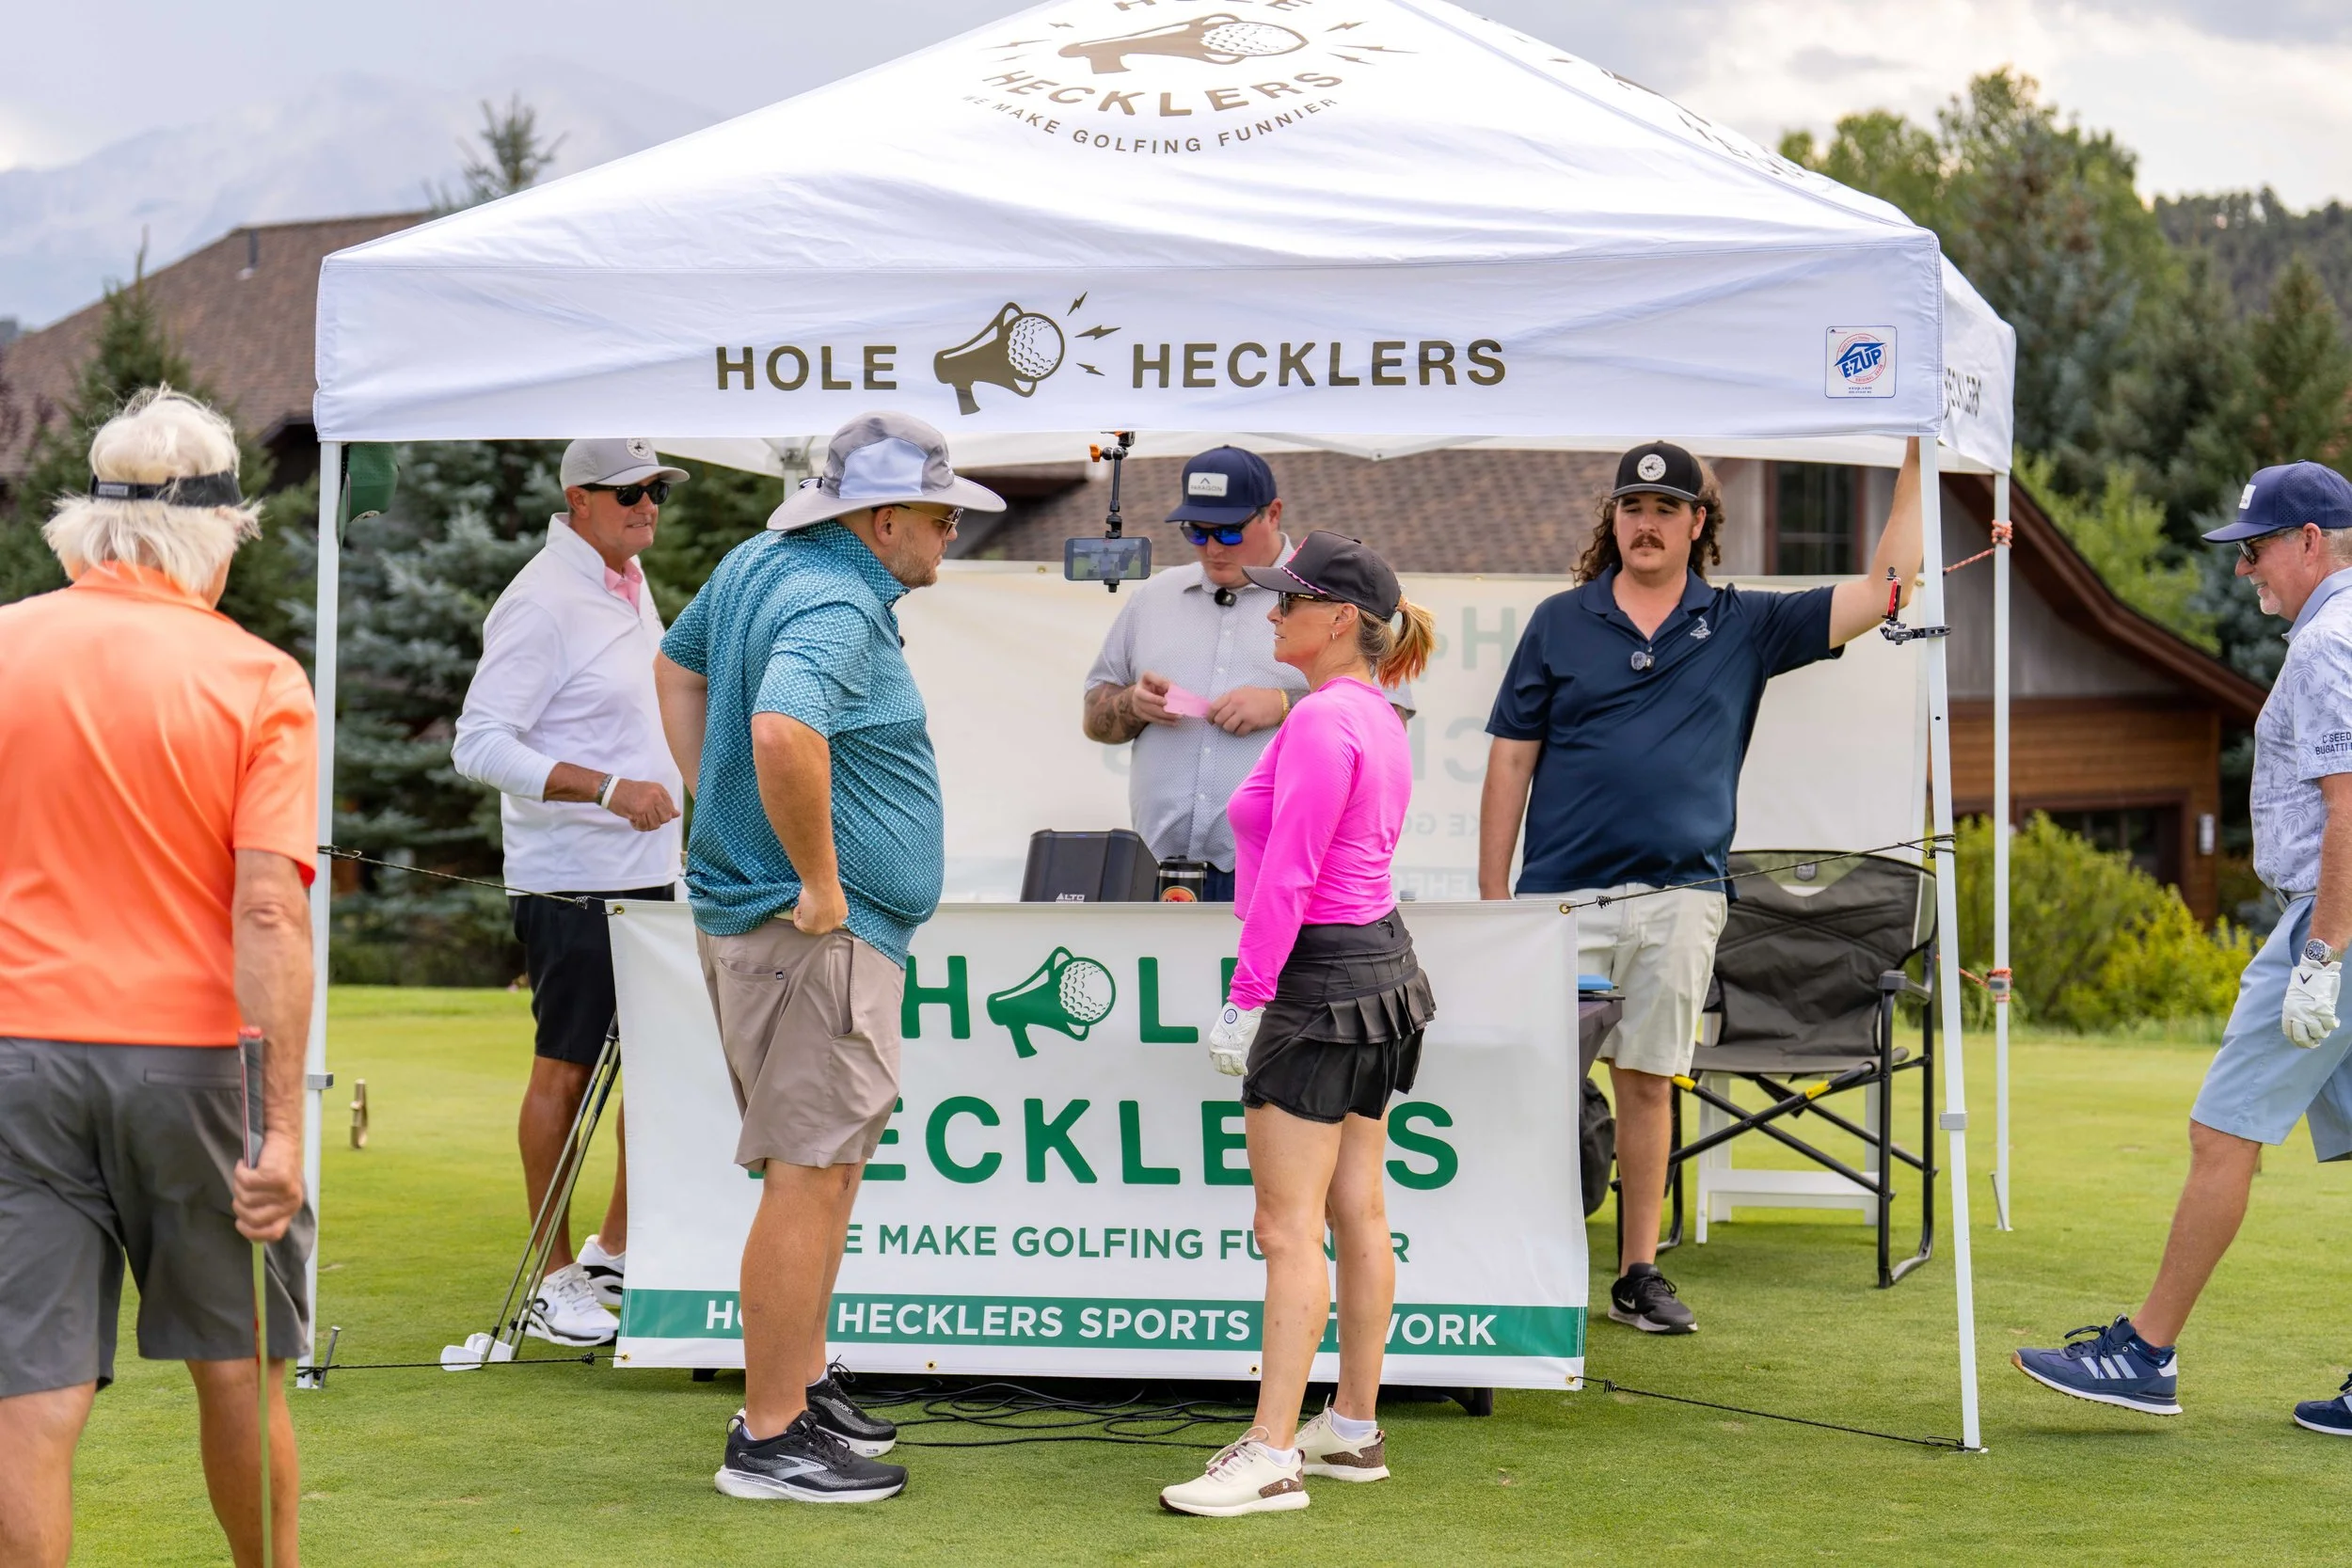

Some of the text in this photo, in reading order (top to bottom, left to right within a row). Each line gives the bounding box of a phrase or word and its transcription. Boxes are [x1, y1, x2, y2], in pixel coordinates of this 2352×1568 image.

[982, 71, 1343, 118] HECKLERS
[992, 103, 1060, 134] MAKE
[1073, 130, 1201, 154] GOLFING
[1217, 99, 1338, 147] FUNNIER
[716, 339, 1506, 390] HOLE HECKLERS
[2315, 742, 2348, 755] BUGATTI
[2328, 731, 2352, 743] SEED
[1056, 892, 1085, 901] ALTO
[879, 1225, 997, 1256] MAKE
[1011, 1226, 1203, 1259] GOLFING
[837, 1303, 1249, 1340] HECKLERS SPORTS
[831, 1398, 853, 1416] BROOKS
